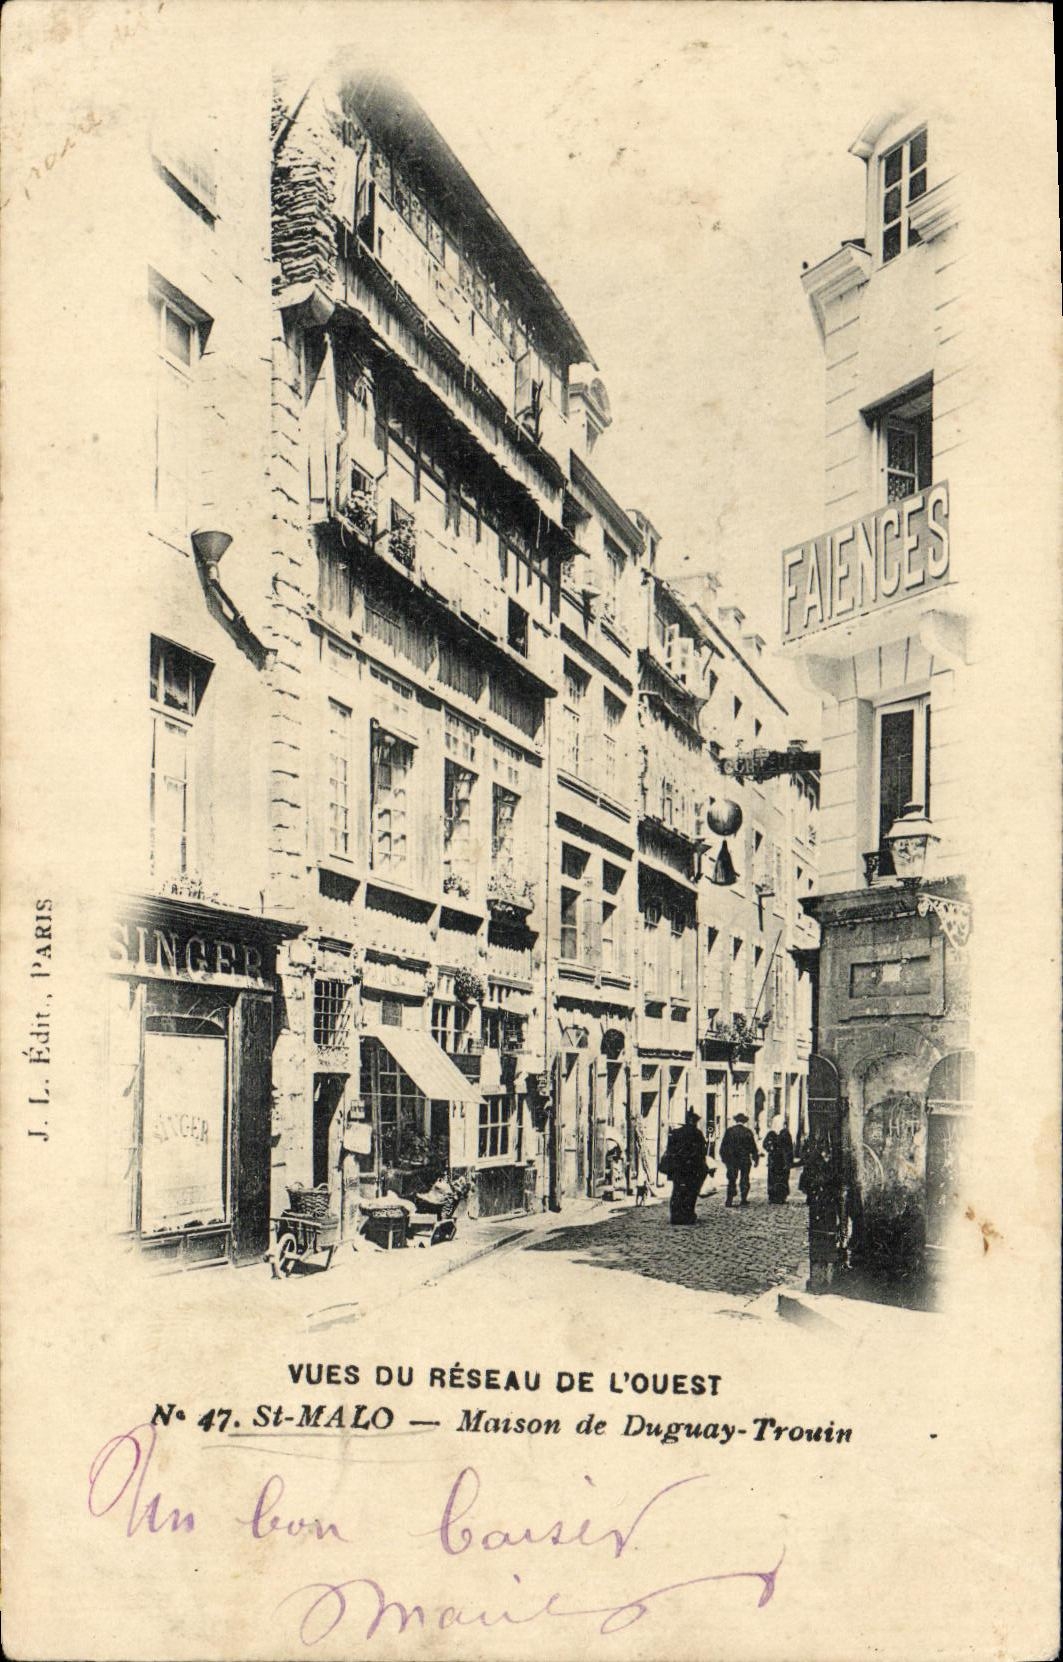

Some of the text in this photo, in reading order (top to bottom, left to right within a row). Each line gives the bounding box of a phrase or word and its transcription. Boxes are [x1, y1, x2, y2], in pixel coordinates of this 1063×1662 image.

[783, 486, 949, 635] FAIENCES
[108, 922, 266, 989] SINGER
[236, 1475, 349, 1539] bon
